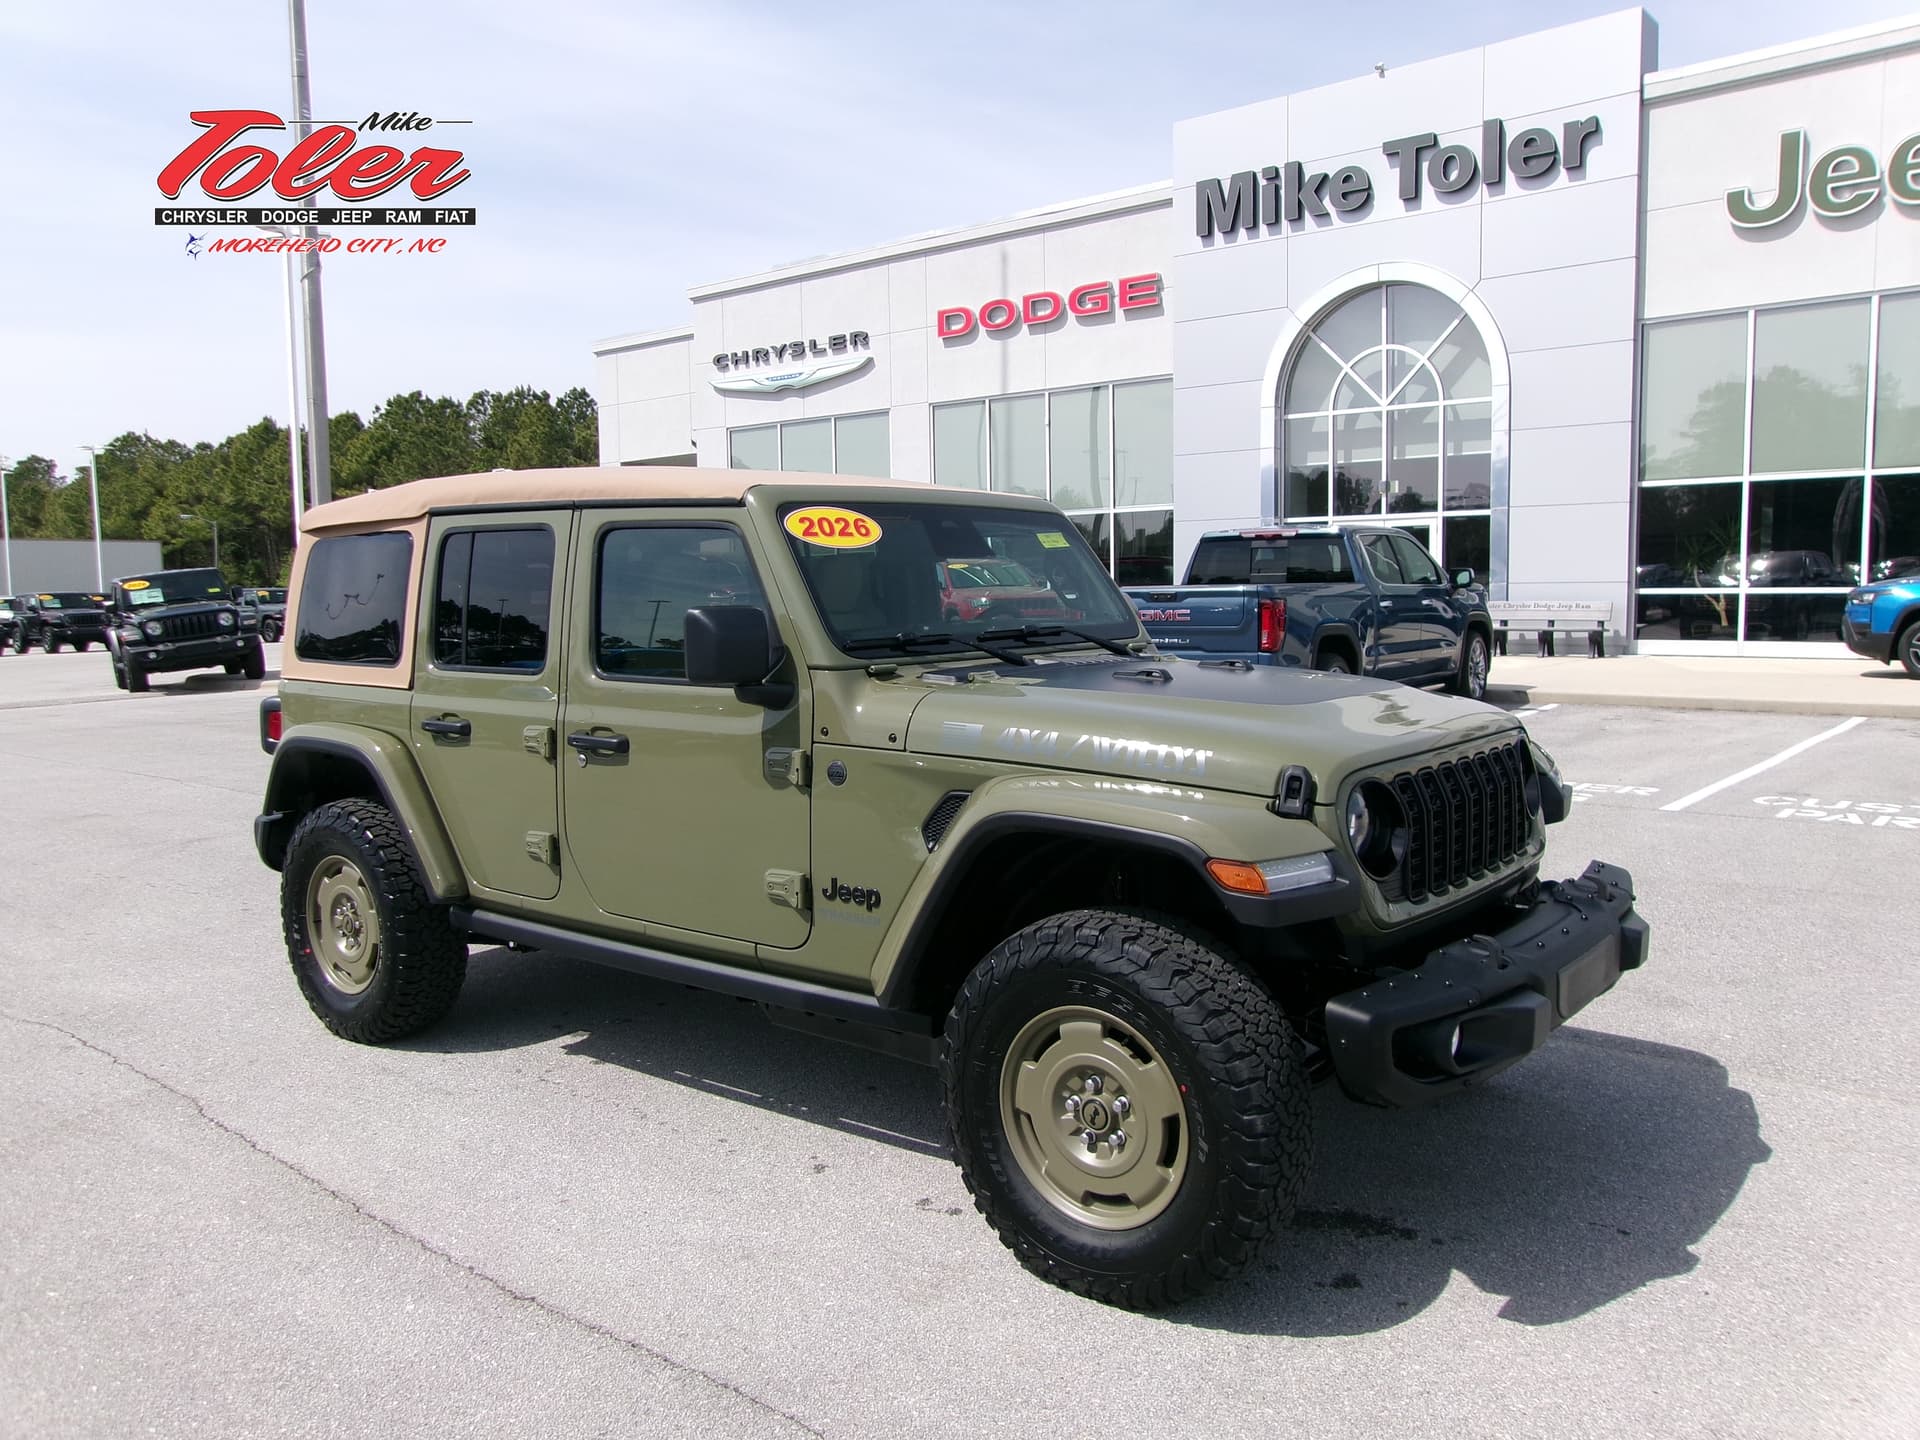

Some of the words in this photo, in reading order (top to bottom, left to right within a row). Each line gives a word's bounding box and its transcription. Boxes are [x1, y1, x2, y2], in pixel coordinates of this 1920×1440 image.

[1195, 161, 1373, 237] Mike
[1382, 115, 1602, 202] Toler
[936, 273, 1160, 339] DODGE
[712, 331, 869, 370] CHRYSLER
[798, 516, 871, 537] 2026
[1138, 609, 1191, 621] GMC
[1752, 796, 1920, 813] CUS
[822, 877, 882, 912] Jeep
